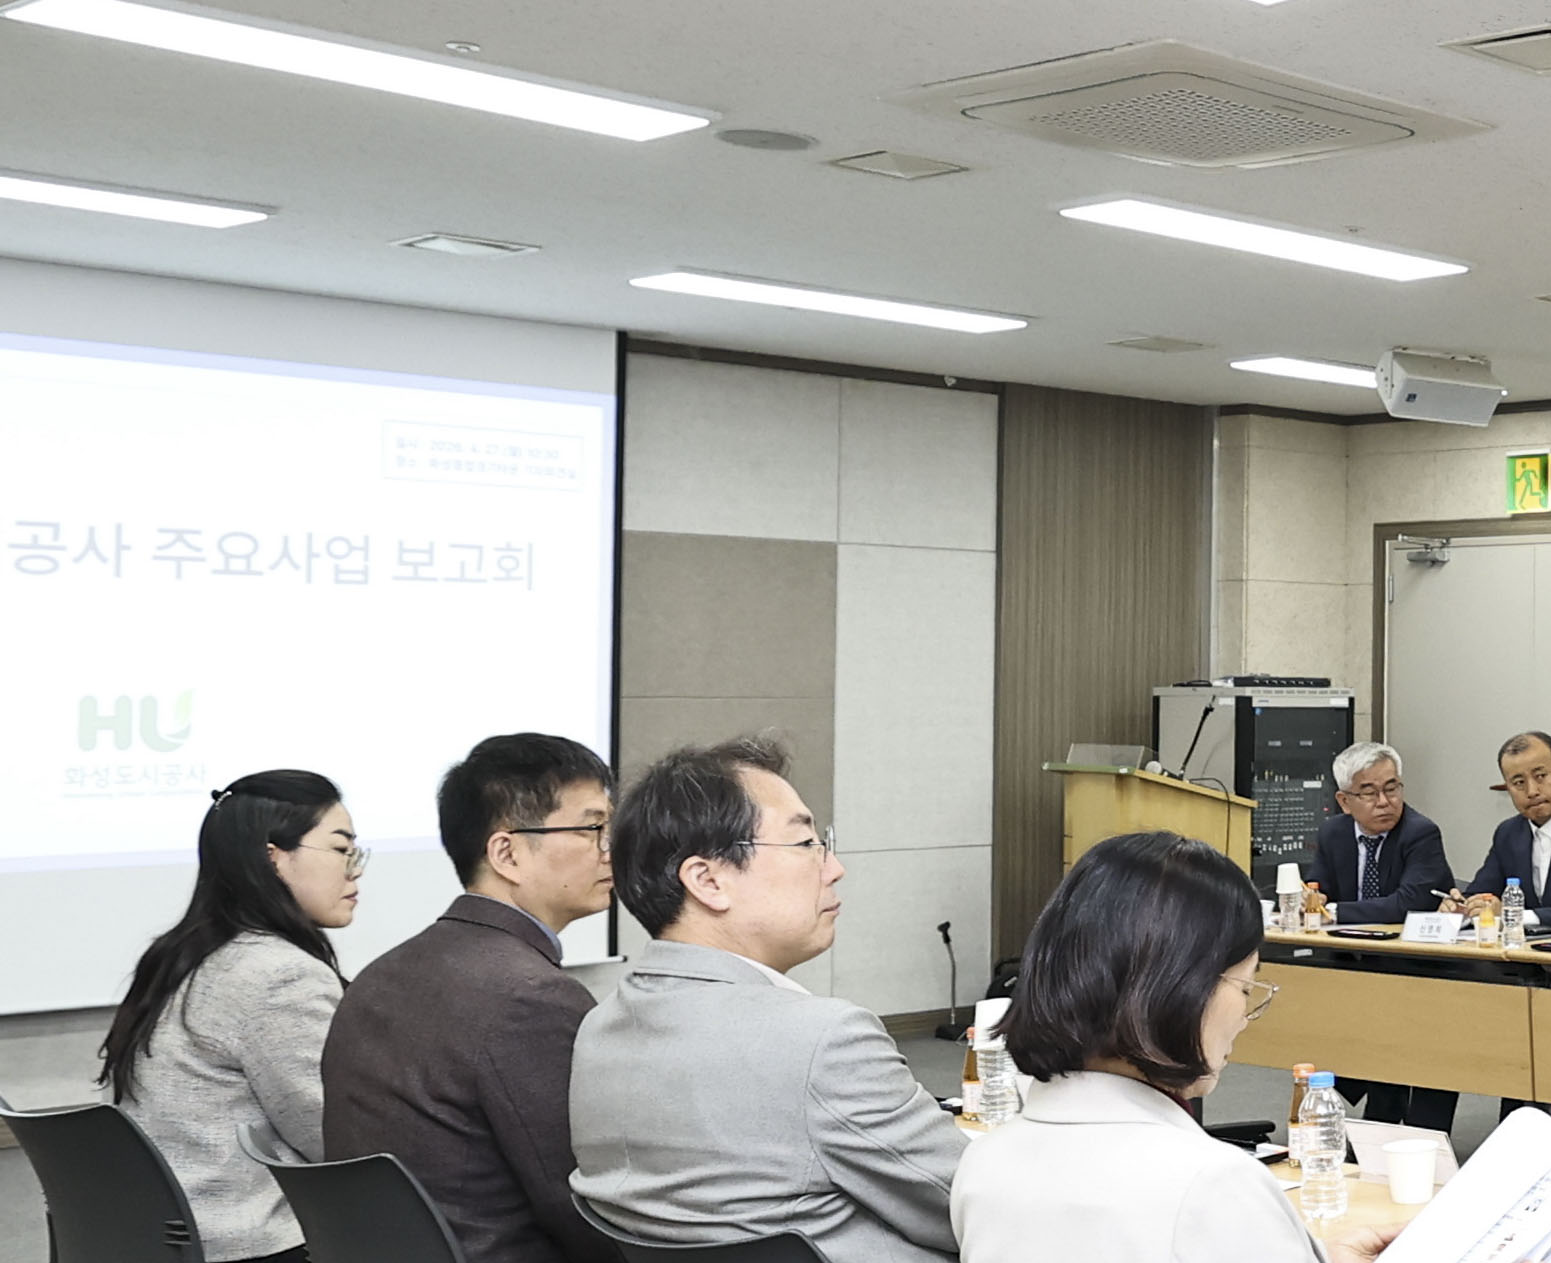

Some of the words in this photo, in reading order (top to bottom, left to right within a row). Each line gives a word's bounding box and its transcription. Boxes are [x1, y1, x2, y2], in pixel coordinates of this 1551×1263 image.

[7, 518, 131, 578] 공사
[151, 525, 372, 586] 주요사업
[391, 538, 536, 592] 보고회
[77, 688, 196, 753] HU
[63, 760, 207, 789] 화성도시공사
